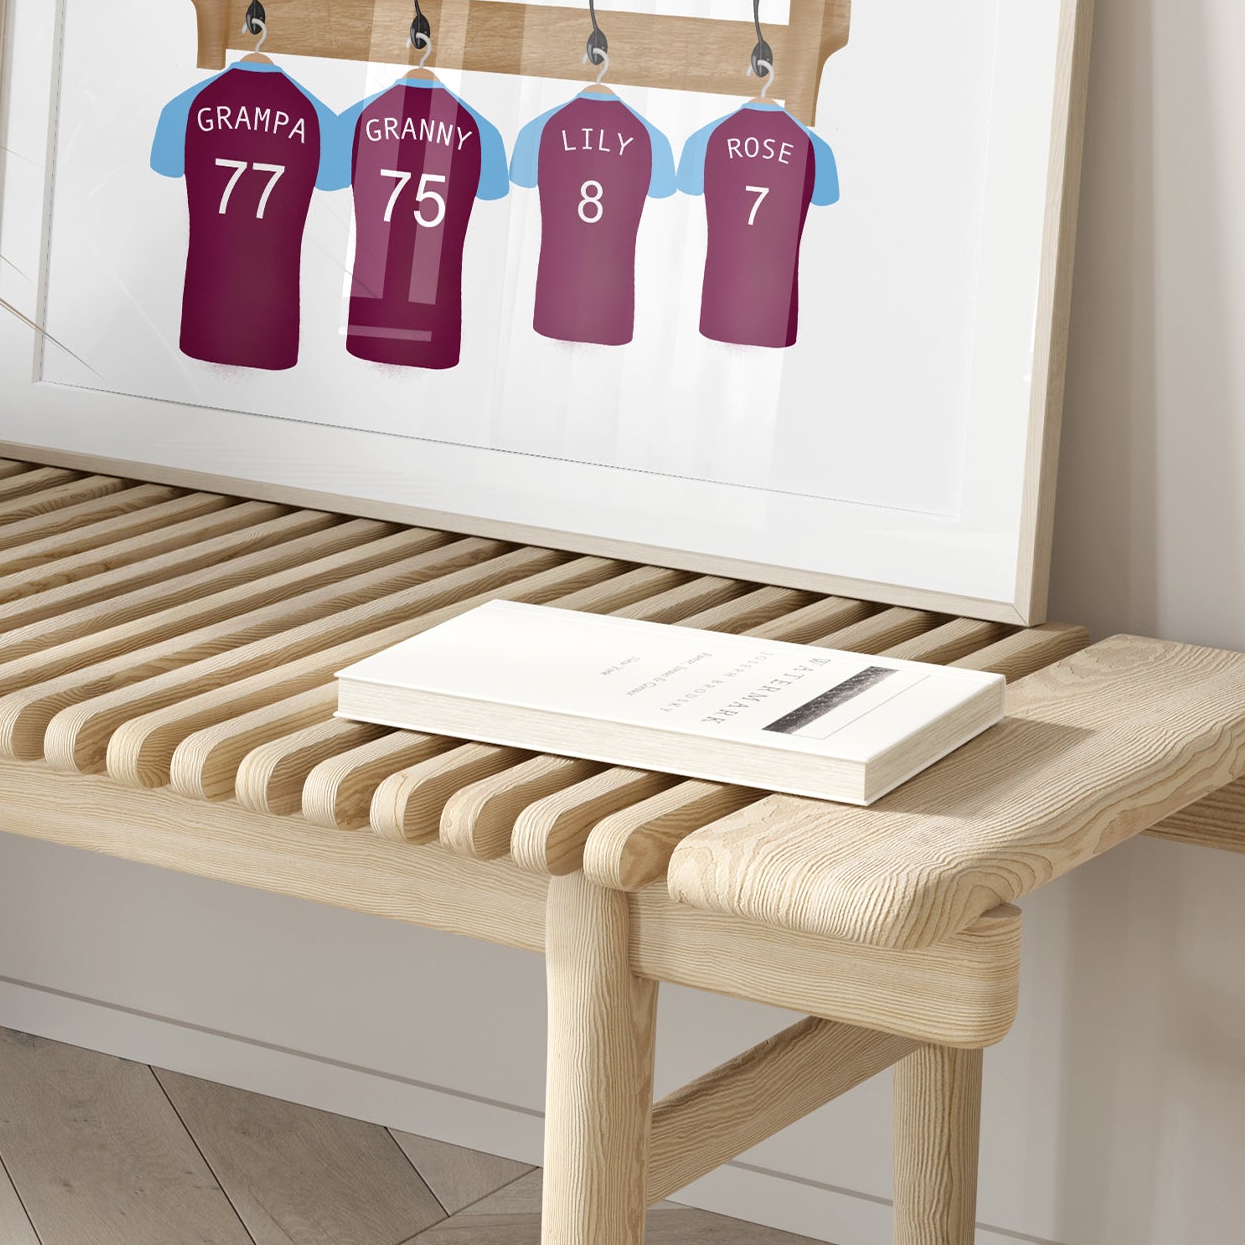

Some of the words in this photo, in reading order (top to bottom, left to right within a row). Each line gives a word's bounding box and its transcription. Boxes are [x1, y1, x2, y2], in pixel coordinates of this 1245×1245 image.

[197, 105, 305, 144] GRAMPA
[365, 117, 473, 150] GRANNY
[561, 128, 634, 156] LILY
[727, 136, 794, 164] ROSE
[215, 158, 286, 219] 77
[380, 168, 446, 228] 75
[577, 179, 604, 224] 8
[745, 185, 770, 226] 7
[701, 657, 832, 724] WATERMARK
